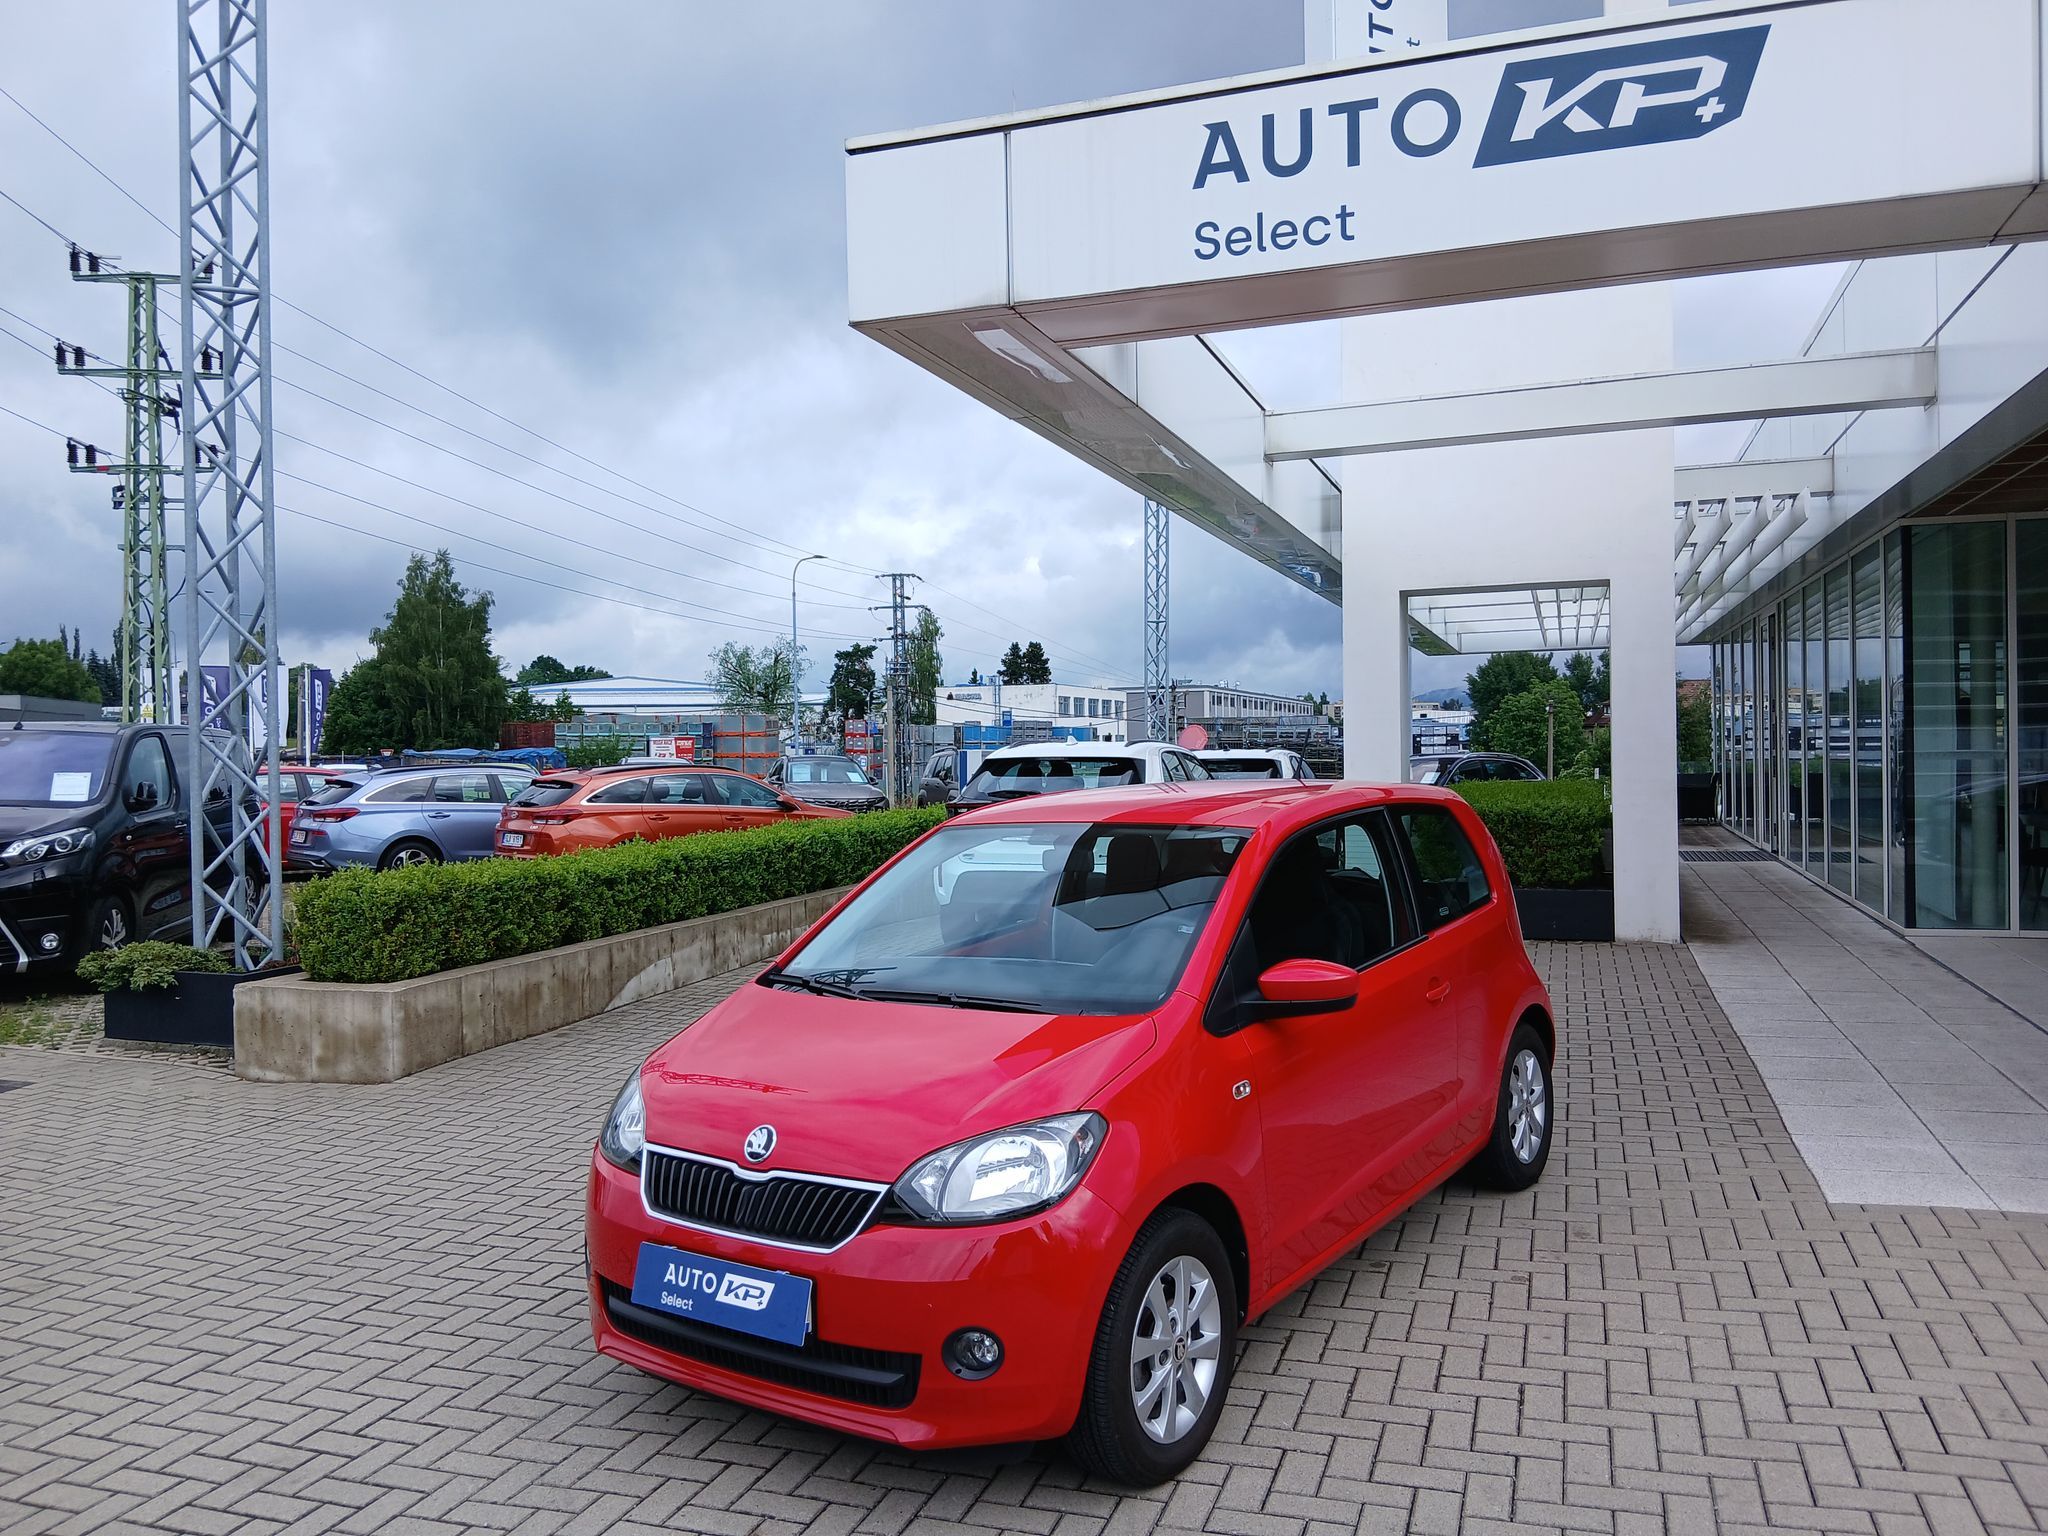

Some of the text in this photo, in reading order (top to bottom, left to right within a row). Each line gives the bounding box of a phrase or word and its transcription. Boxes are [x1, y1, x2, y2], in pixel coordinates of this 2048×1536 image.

[1192, 88, 1461, 190] AUTO
[1193, 204, 1355, 260] Select
[663, 1262, 717, 1294] AUTO
[660, 1290, 693, 1311] Select
